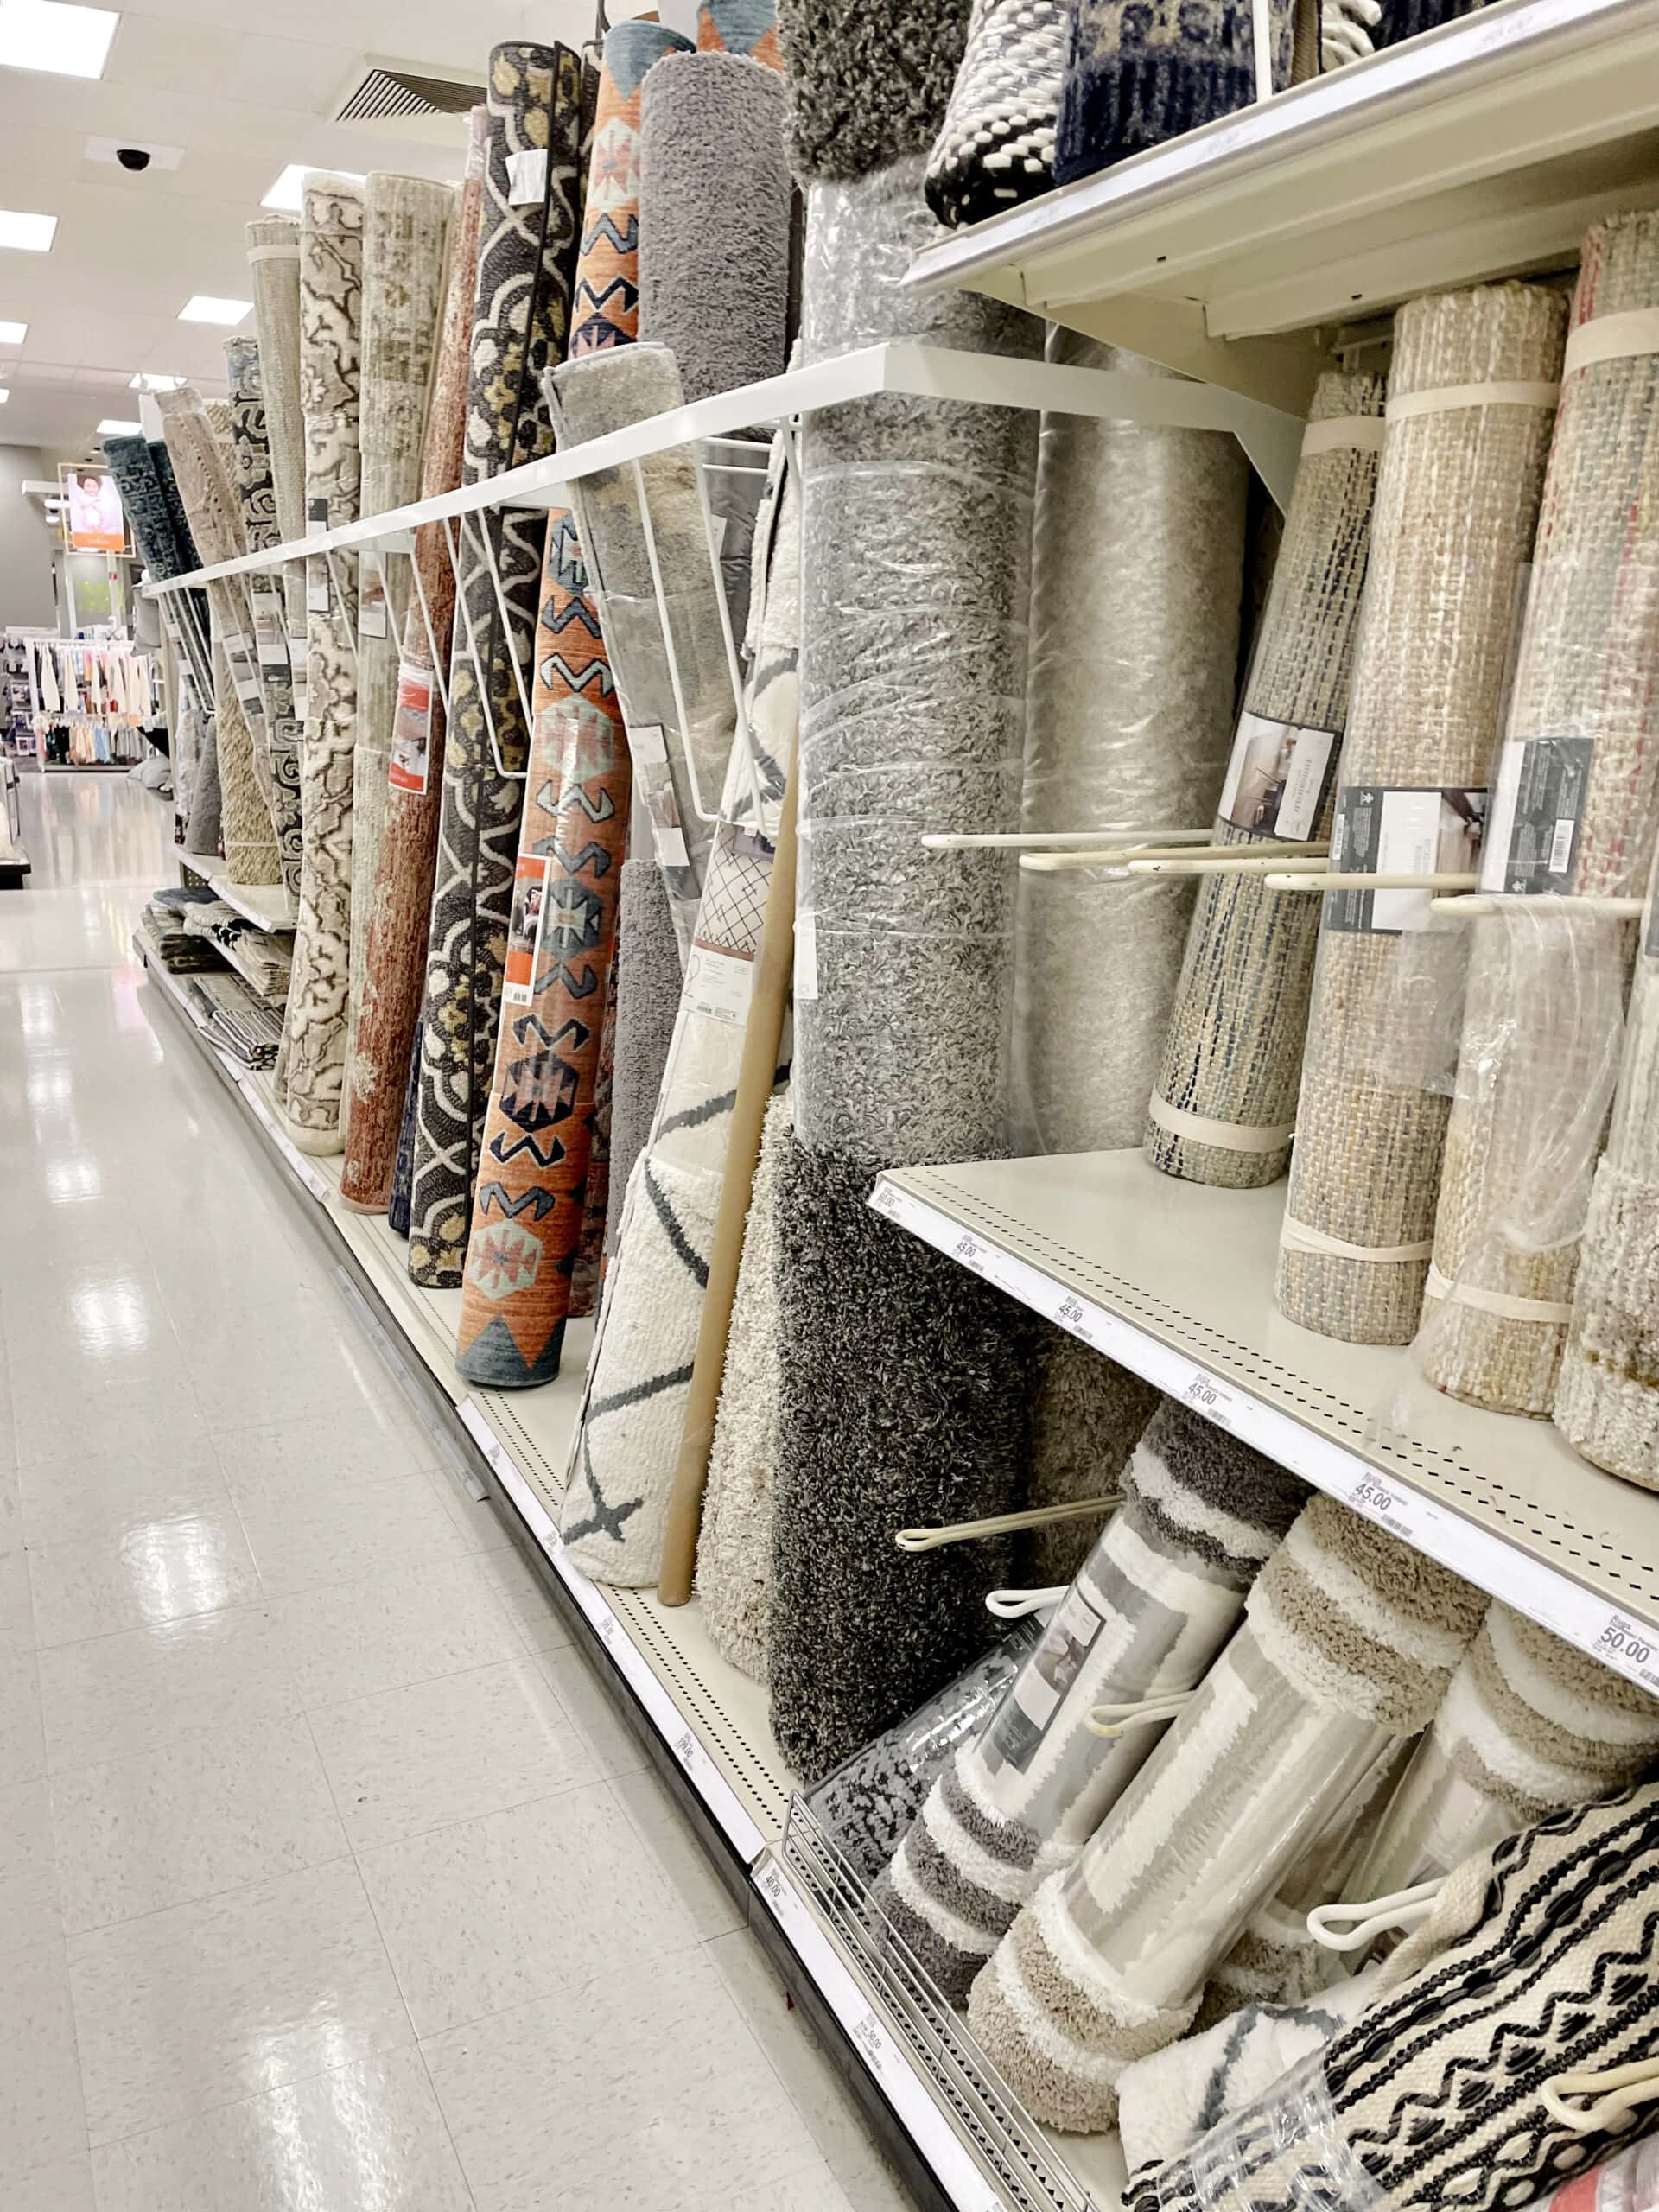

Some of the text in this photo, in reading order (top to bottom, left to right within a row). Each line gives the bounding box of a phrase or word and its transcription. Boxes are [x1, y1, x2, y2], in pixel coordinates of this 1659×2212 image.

[1058, 1304, 1083, 1322] 45.00
[1188, 1382, 1217, 1405] 45.00
[1355, 1483, 1392, 1510] 45.00
[1600, 1626, 1651, 1663] 50.00
